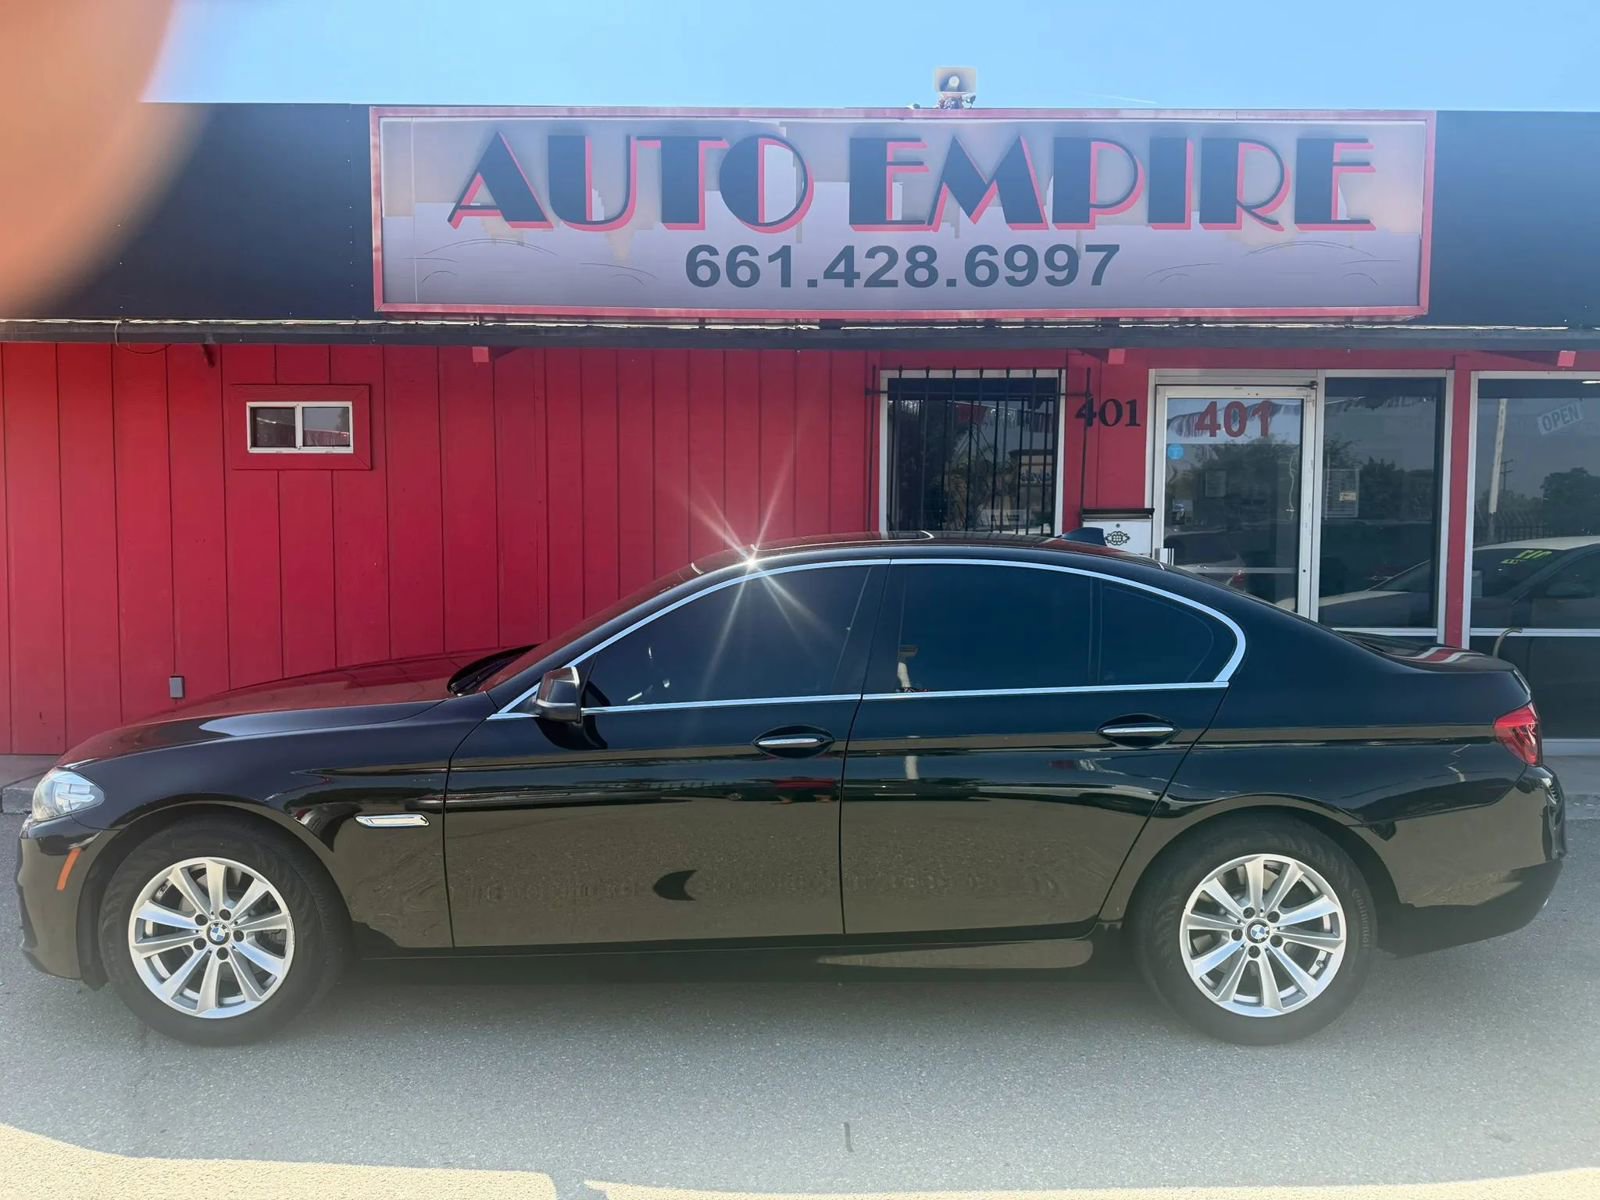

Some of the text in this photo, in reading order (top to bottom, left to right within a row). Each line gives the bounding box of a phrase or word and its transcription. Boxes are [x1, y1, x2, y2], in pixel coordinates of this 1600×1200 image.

[448, 131, 1377, 234] AUTO EMPIRE
[685, 244, 1121, 289] 661.428.6997
[1075, 398, 1141, 428] 401
[1194, 400, 1273, 438] 401
[1541, 404, 1580, 431] OPEN
